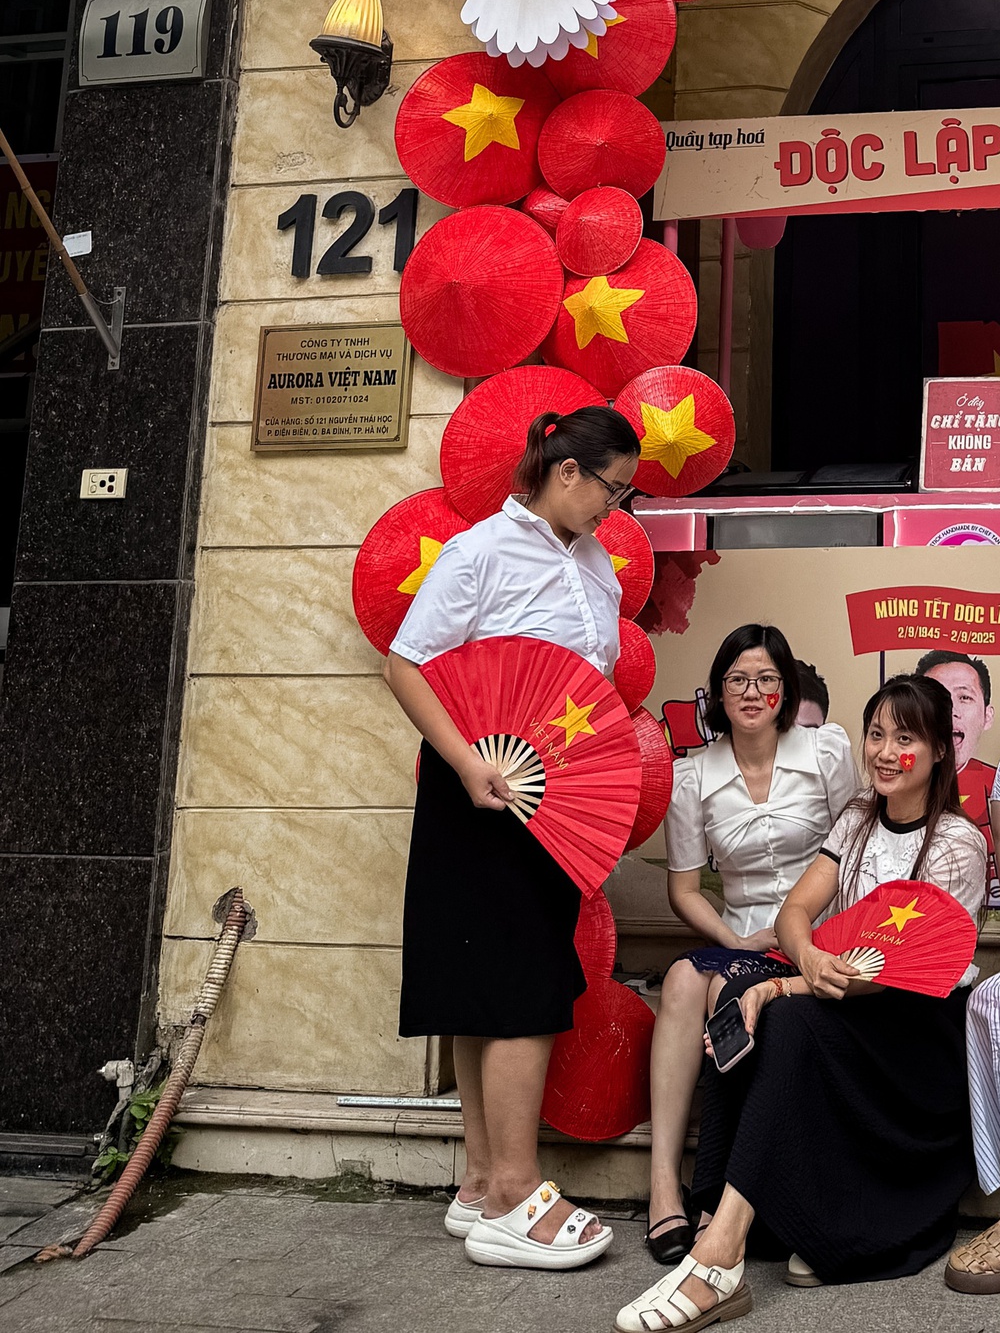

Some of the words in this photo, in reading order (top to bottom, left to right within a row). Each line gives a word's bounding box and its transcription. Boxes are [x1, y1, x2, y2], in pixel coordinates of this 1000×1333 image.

[97, 6, 184, 59] 119
[666, 130, 704, 151] Quầy
[708, 132, 732, 150] tạp
[736, 128, 765, 145] hoá
[774, 128, 885, 194] ĐỘC
[277, 188, 419, 279] 121
[300, 338, 328, 348] CÔNG
[330, 339, 342, 347] TY
[344, 338, 370, 346] TNHH
[319, 351, 337, 362] MẠI
[339, 350, 352, 359] VÀ
[354, 350, 377, 361] DỊCH
[380, 349, 393, 360] VỤ
[267, 372, 324, 389] AURORA
[328, 366, 360, 392] VIỆT
[363, 369, 397, 386] NAM
[291, 397, 313, 405] MST:
[316, 395, 369, 404] 0102071024
[316, 416, 327, 424] 121
[360, 415, 376, 423] THÁI
[930, 410, 963, 429] CHỈ
[321, 427, 331, 435] BA
[948, 433, 992, 450] KHÔNG
[950, 454, 986, 472] BÁN
[874, 597, 919, 620] MỪNG
[923, 597, 951, 620] TẾT
[954, 603, 985, 625] ĐỘC
[897, 626, 941, 639] 2/9/1945
[950, 630, 996, 644] 2/9/2025
[528, 718, 549, 745] VIET
[545, 742, 569, 770] NAM
[881, 935, 905, 946] NAM
